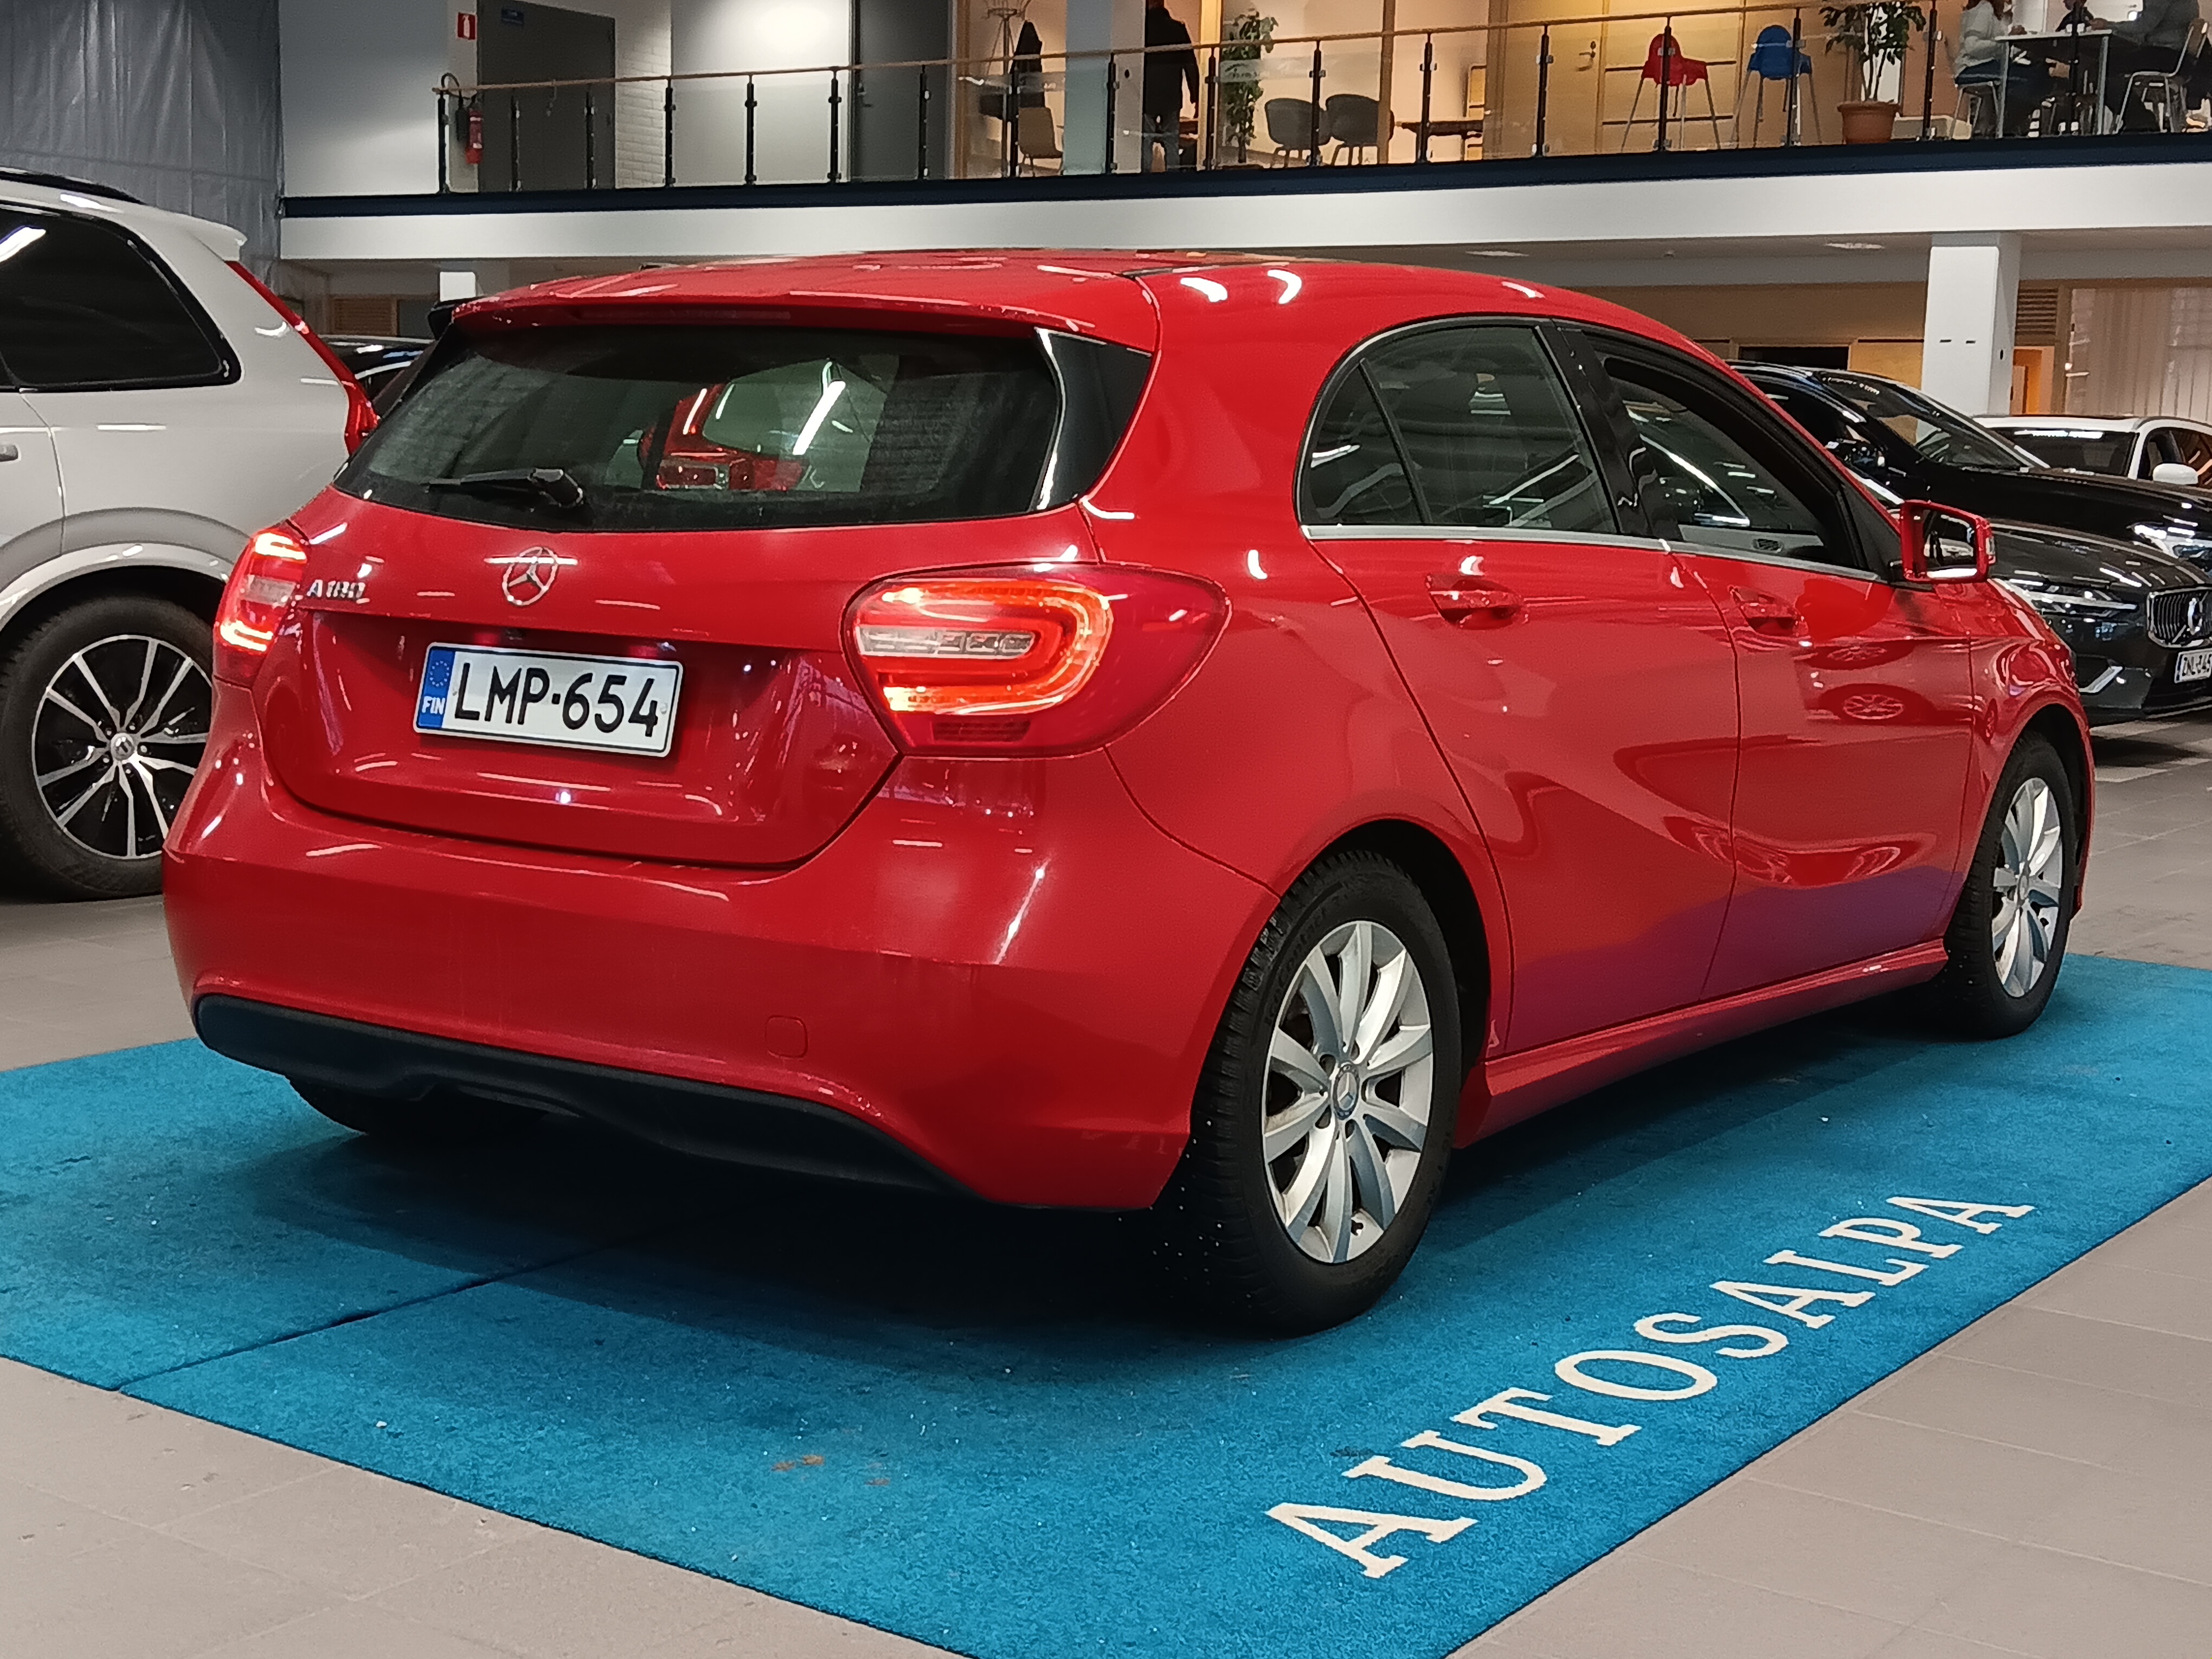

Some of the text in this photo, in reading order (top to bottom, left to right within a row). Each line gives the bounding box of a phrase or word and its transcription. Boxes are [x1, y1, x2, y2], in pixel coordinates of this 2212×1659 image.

[422, 696, 446, 715] FIN
[454, 663, 659, 737] LMP-654
[1265, 1196, 2035, 1579] AUTOSALPA
